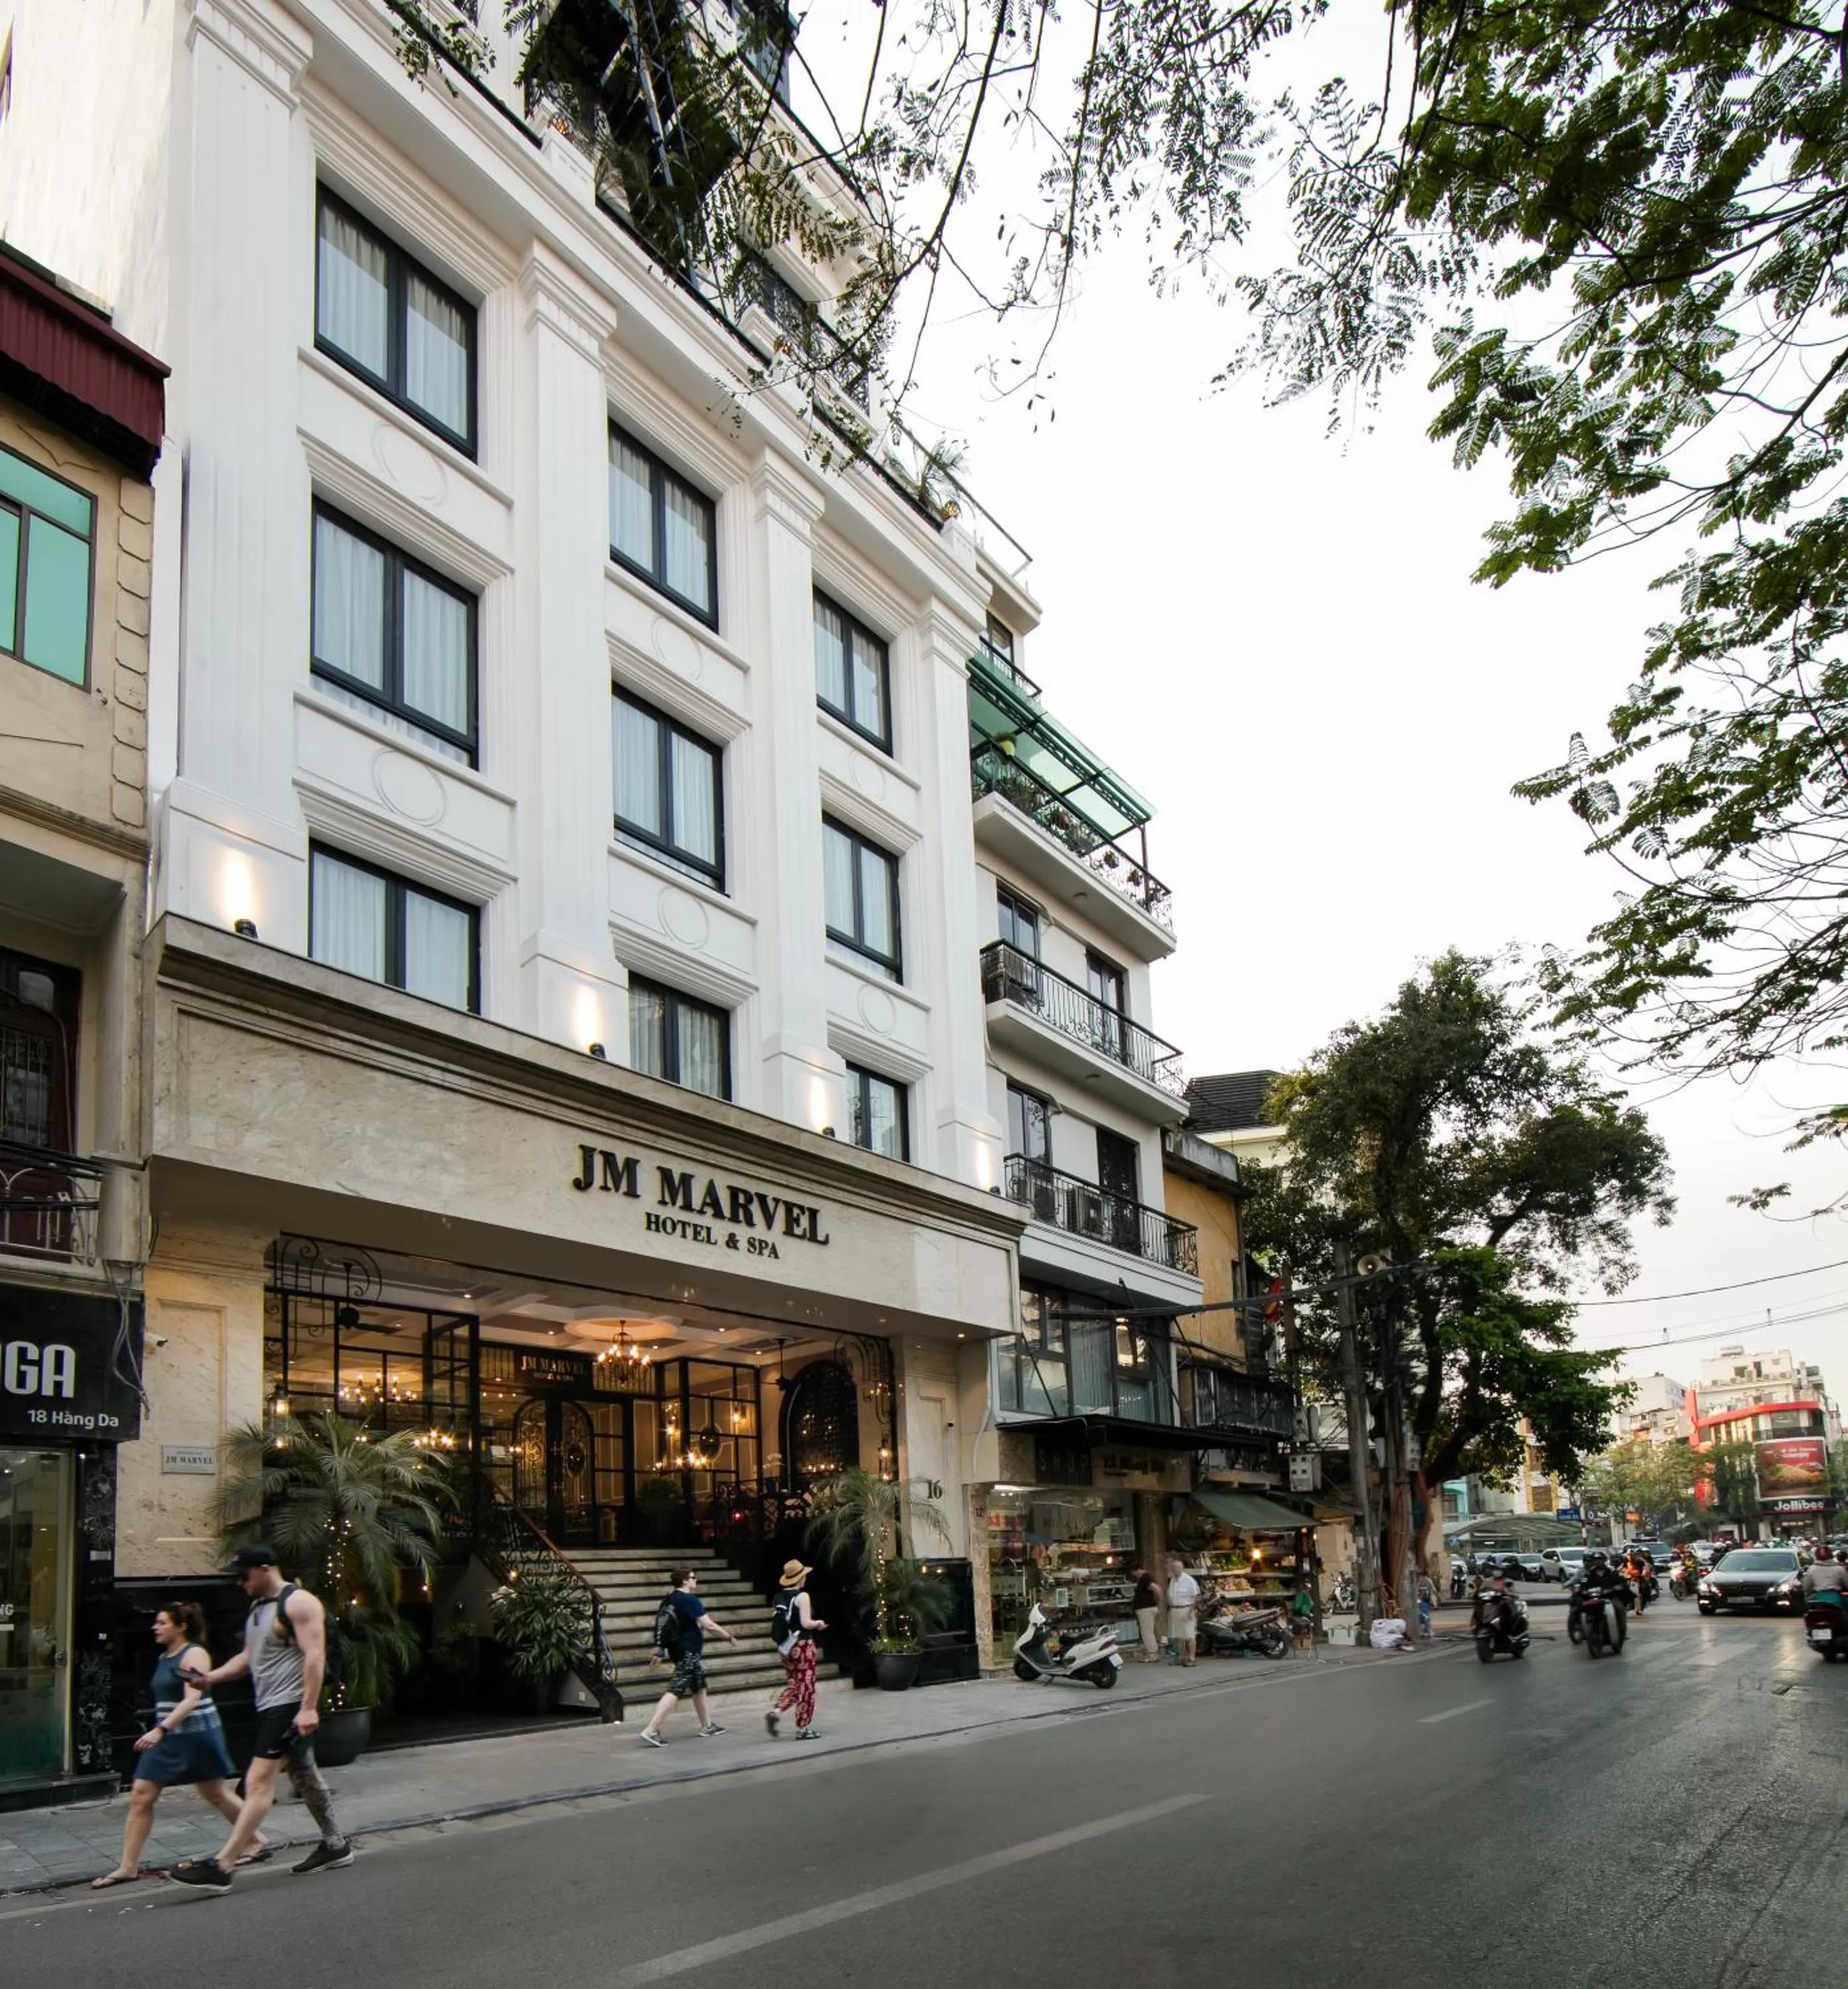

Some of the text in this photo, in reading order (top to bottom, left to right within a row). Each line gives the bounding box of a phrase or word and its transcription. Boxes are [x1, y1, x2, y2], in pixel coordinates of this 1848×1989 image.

[573, 1144, 829, 1245] JM MARVEL
[645, 1212, 780, 1260] HOTEL & SPA
[0, 1341, 76, 1398] GA
[521, 1356, 536, 1370] JM
[28, 1410, 119, 1429] 18 Hàng Da
[164, 1455, 177, 1464] JM
[927, 1479, 943, 1499] 16
[1774, 1500, 1824, 1511] Jollibee
